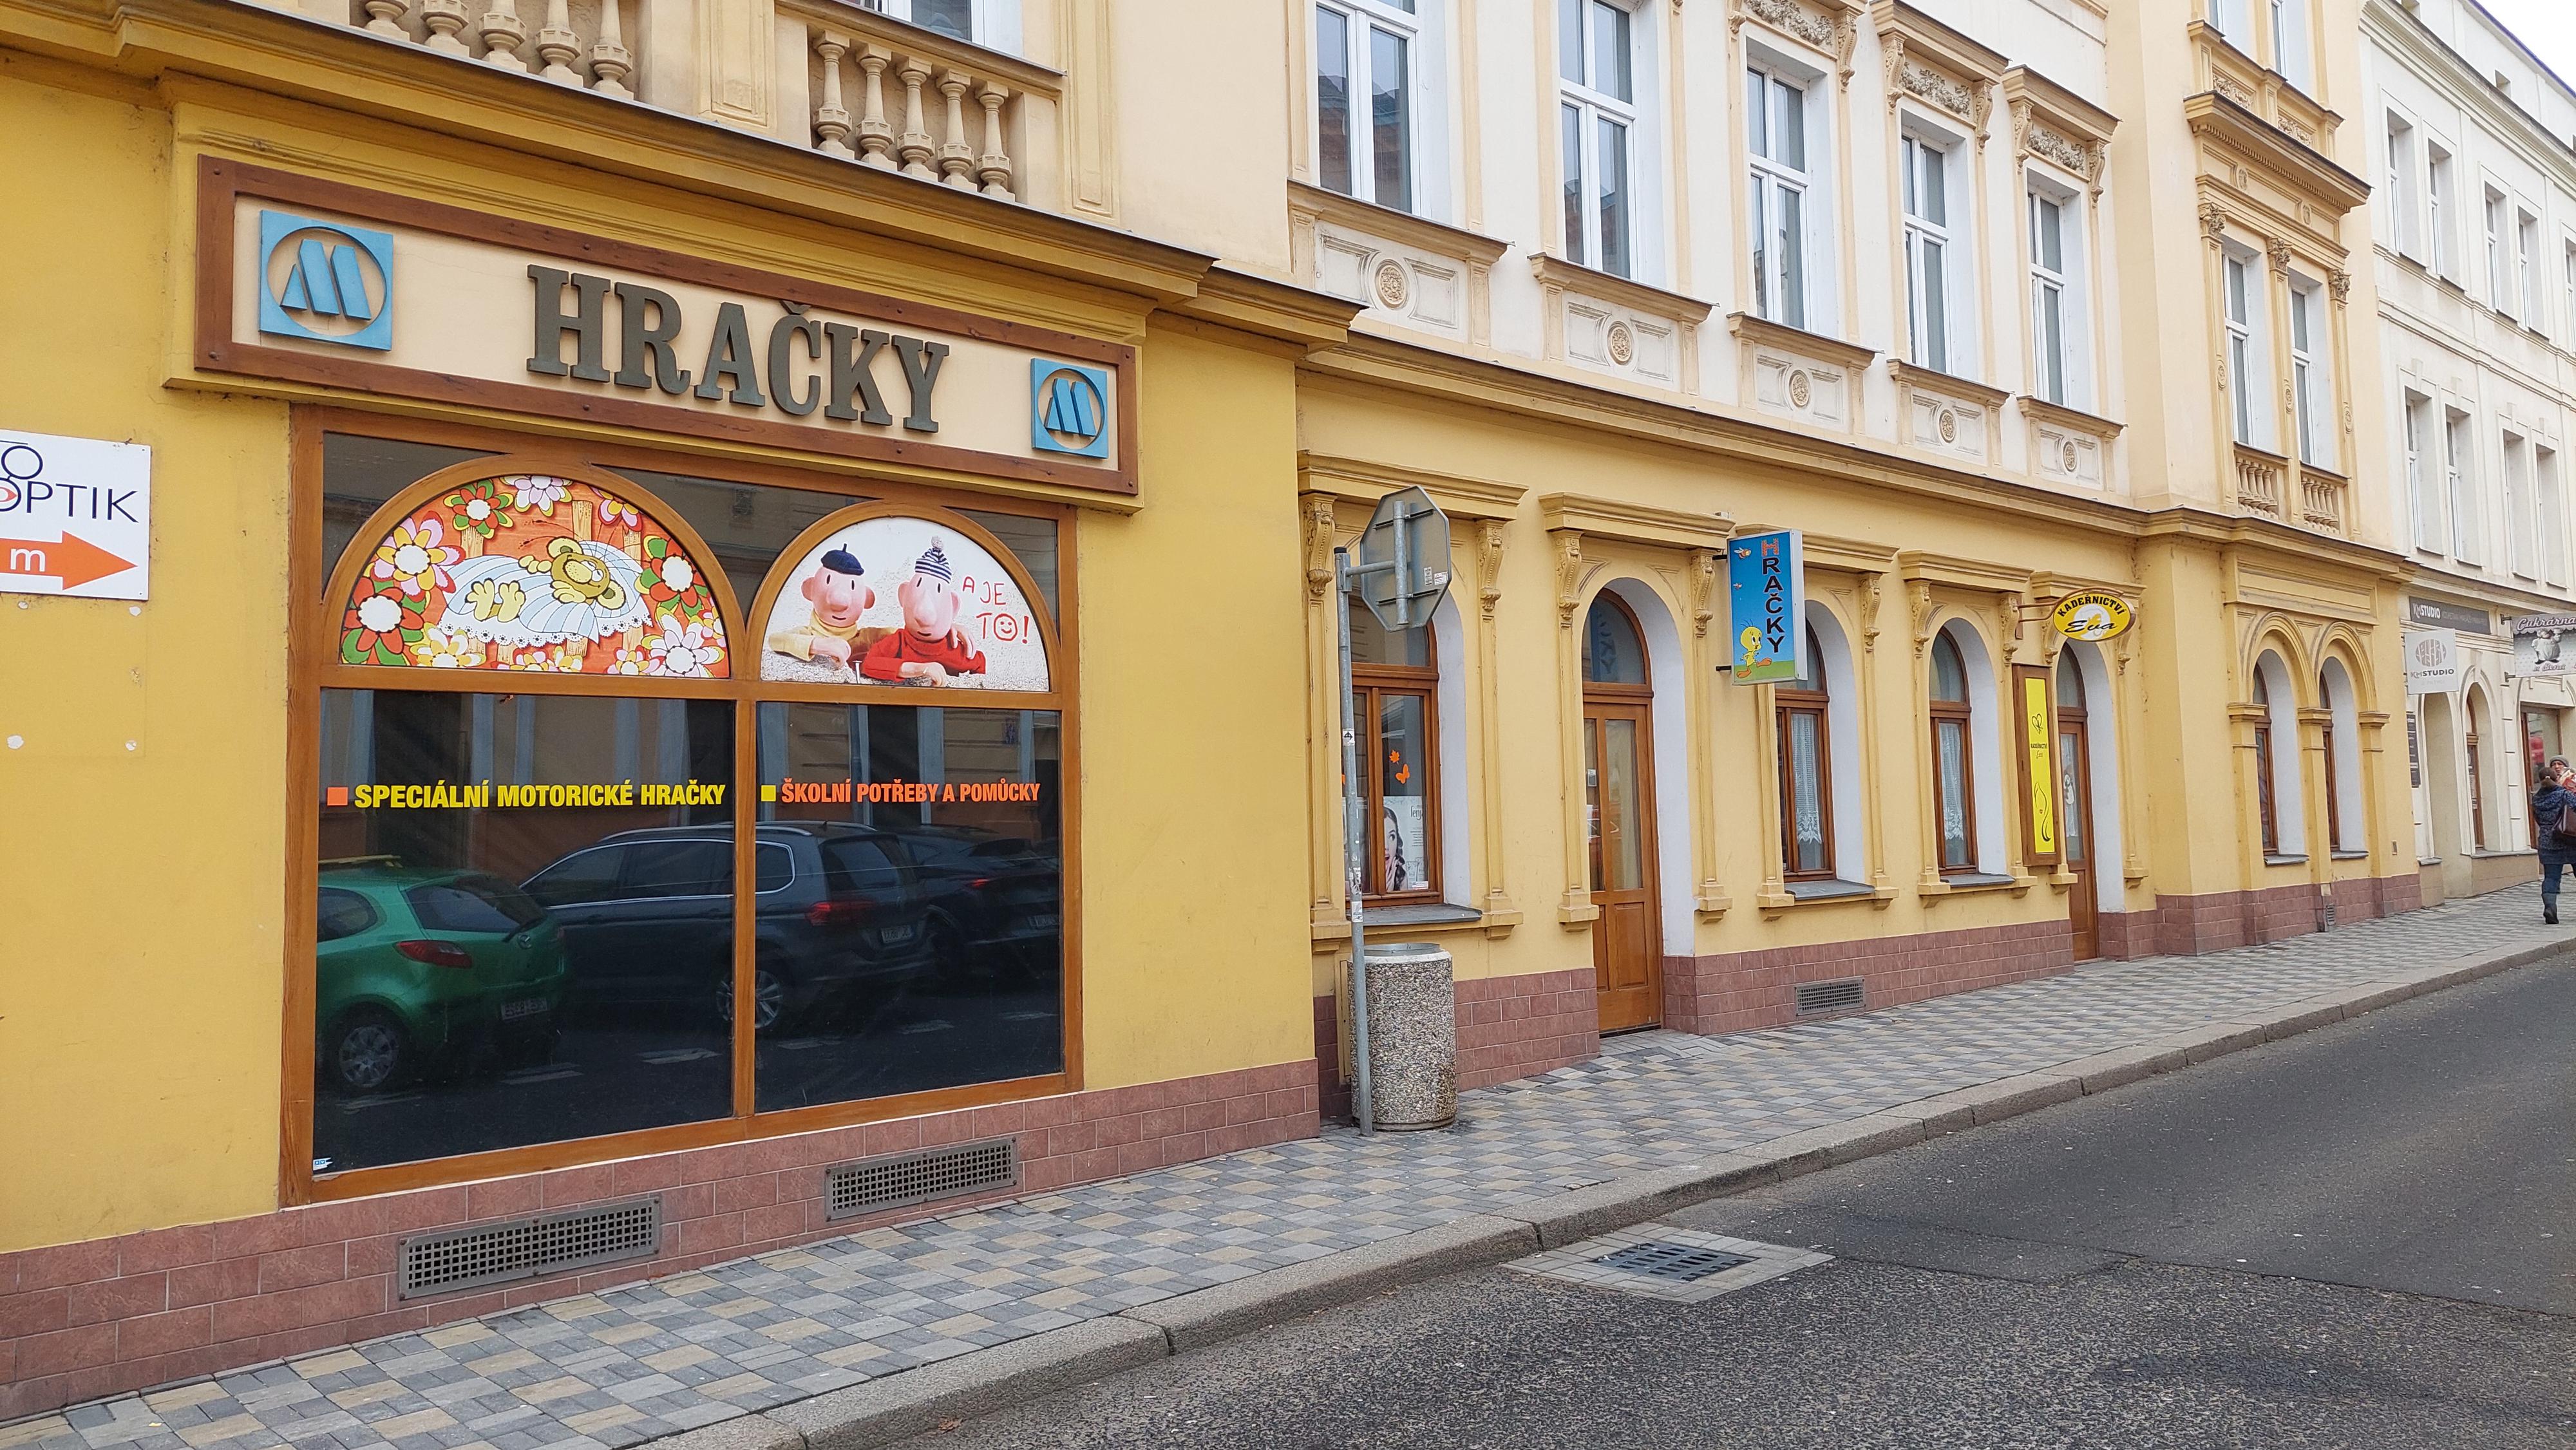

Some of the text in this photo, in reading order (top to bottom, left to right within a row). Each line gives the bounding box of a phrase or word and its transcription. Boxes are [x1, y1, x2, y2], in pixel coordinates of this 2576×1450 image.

[526, 264, 950, 433] HRAČKY
[962, 576, 1007, 605] A JE
[1761, 537, 1785, 654] HRAČKY
[2057, 594, 2127, 617] KADEŘNICTVÍ
[2064, 619, 2117, 633] Eva
[2517, 616, 2576, 632] Cukrárna
[354, 779, 726, 809] SPECIÁLNÍ MOTORICKÉ HRAČKY
[781, 777, 1041, 803] ŠKOLNÍ POTŘEBY A POMŮCKY
